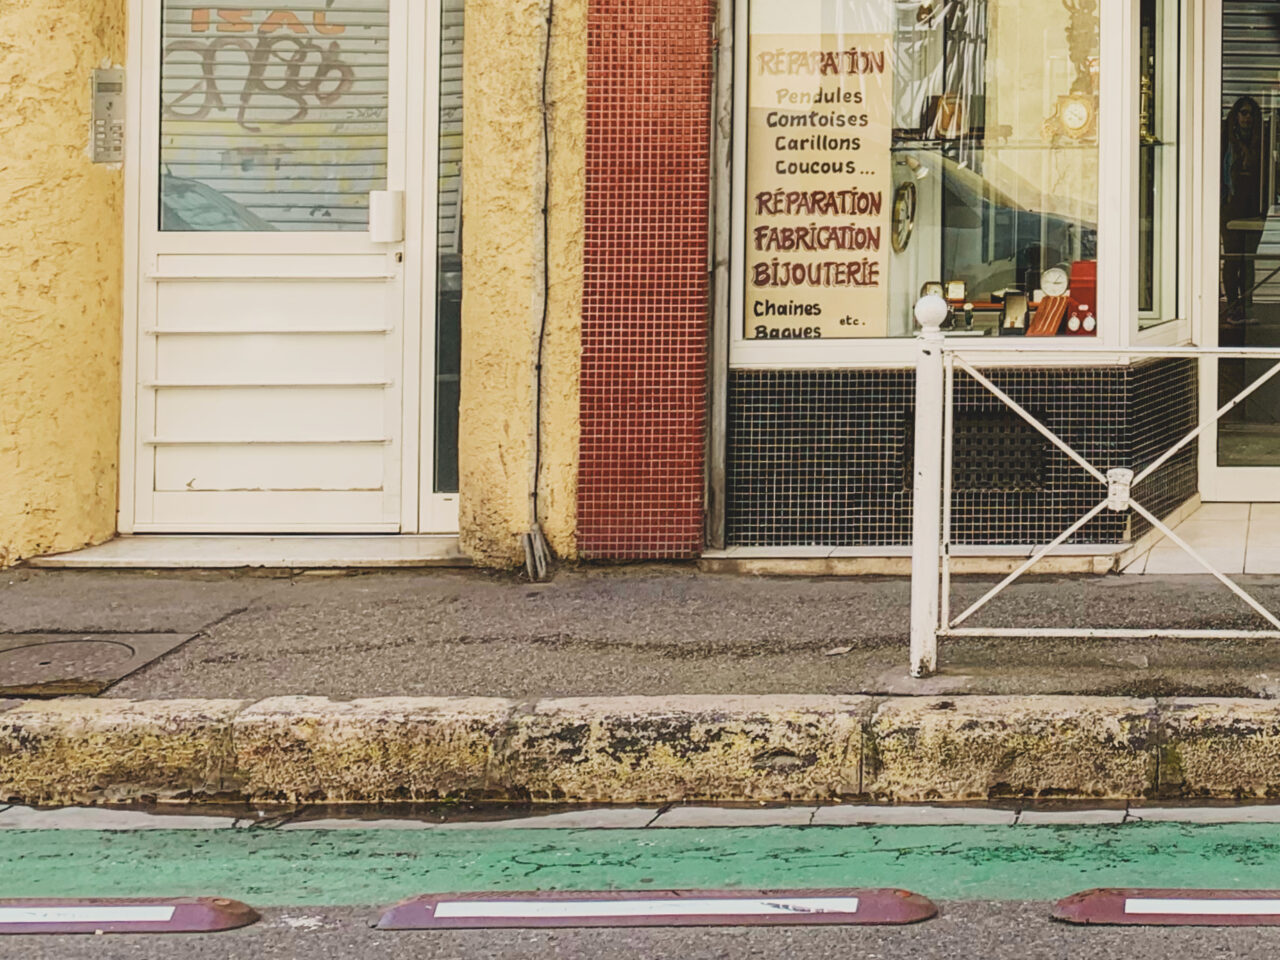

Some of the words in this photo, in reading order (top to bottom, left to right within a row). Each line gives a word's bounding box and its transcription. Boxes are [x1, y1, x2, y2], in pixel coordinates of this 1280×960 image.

[758, 46, 885, 77] RÉPARATION
[776, 86, 863, 105] Pendules
[766, 110, 869, 128] Comtoises
[775, 134, 861, 151] Carillons
[754, 186, 882, 217] RÉPARATION
[753, 221, 881, 253] FABRICATION
[751, 256, 880, 288] BIJOUTERIE
[839, 315, 866, 326] etc.
